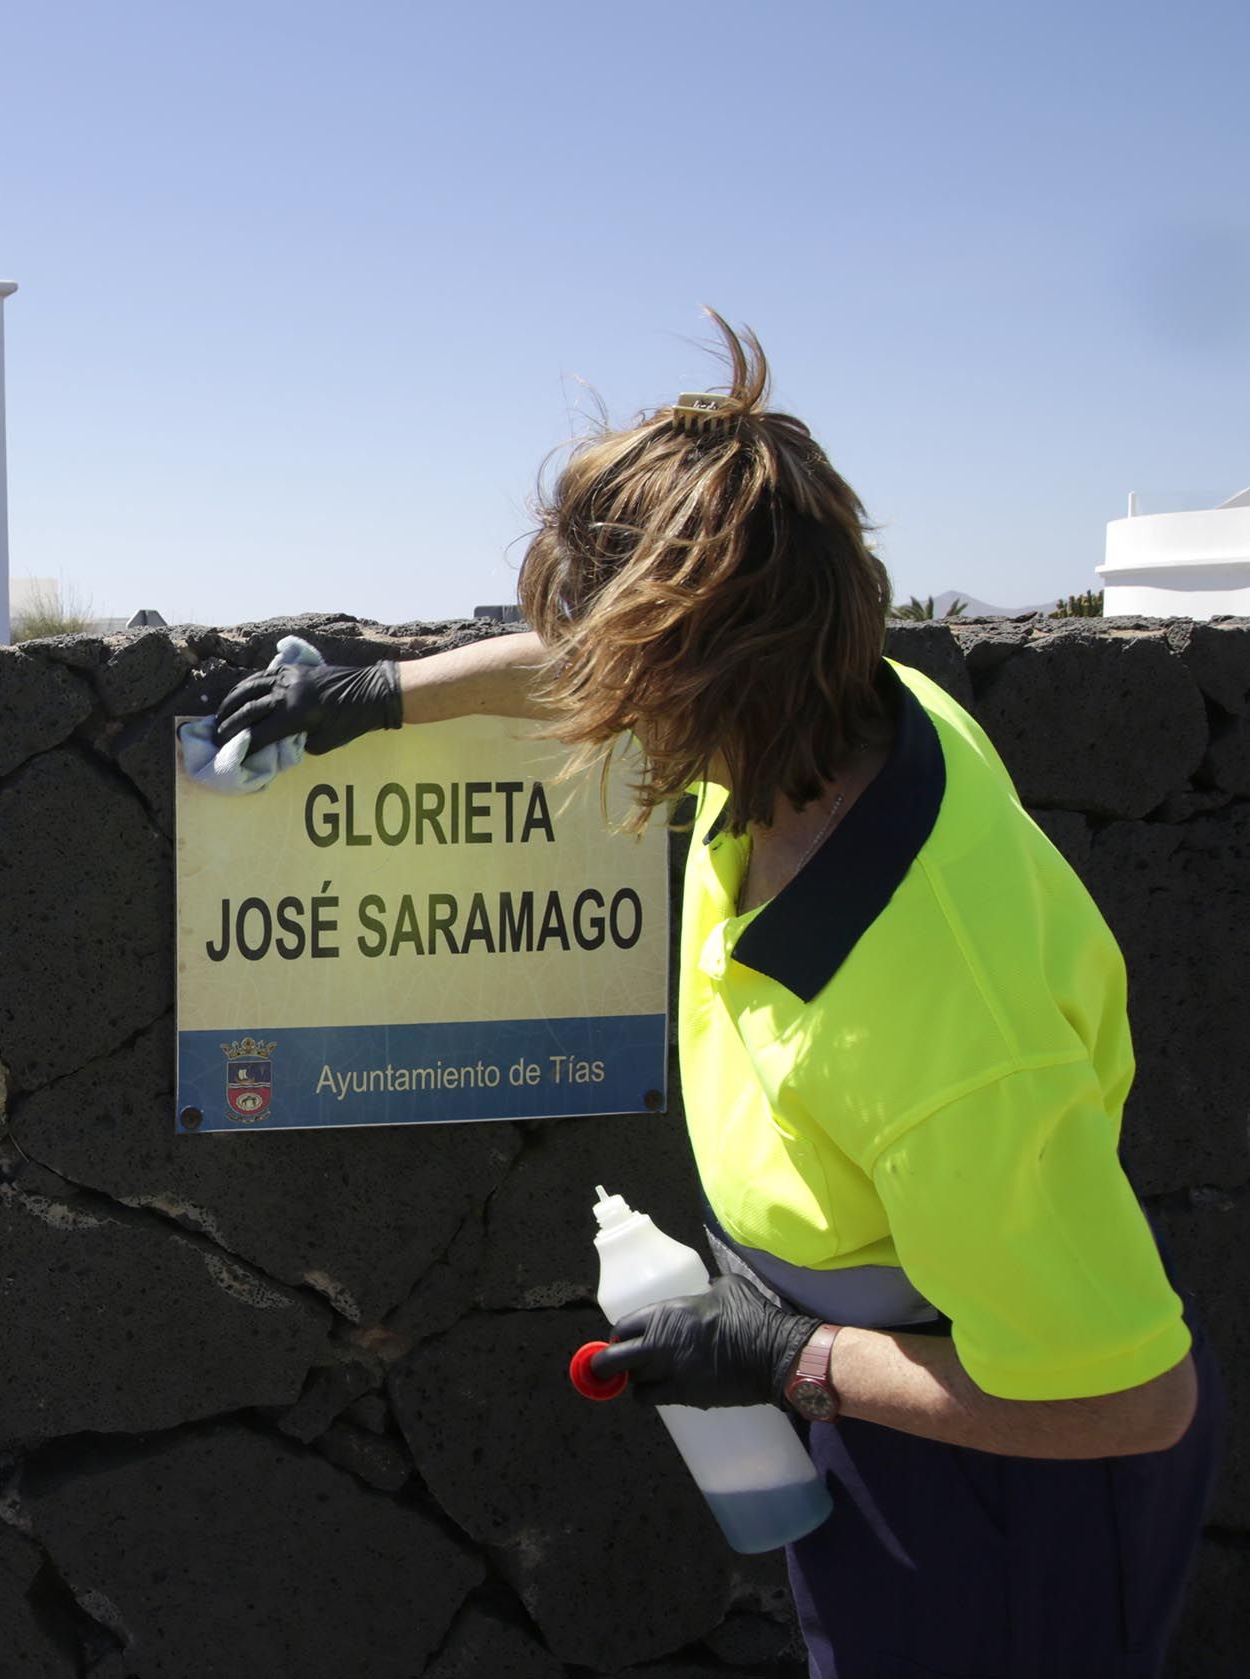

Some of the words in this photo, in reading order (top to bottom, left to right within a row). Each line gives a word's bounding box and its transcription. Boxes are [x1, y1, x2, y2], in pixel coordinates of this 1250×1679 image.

[305, 781, 555, 848] GLORIETA
[206, 881, 340, 962] JOSÉ
[357, 888, 643, 958] SARAMAGO
[316, 1061, 500, 1100] Ayuntamiento
[509, 1057, 541, 1086] de
[549, 1055, 605, 1084] Tías
